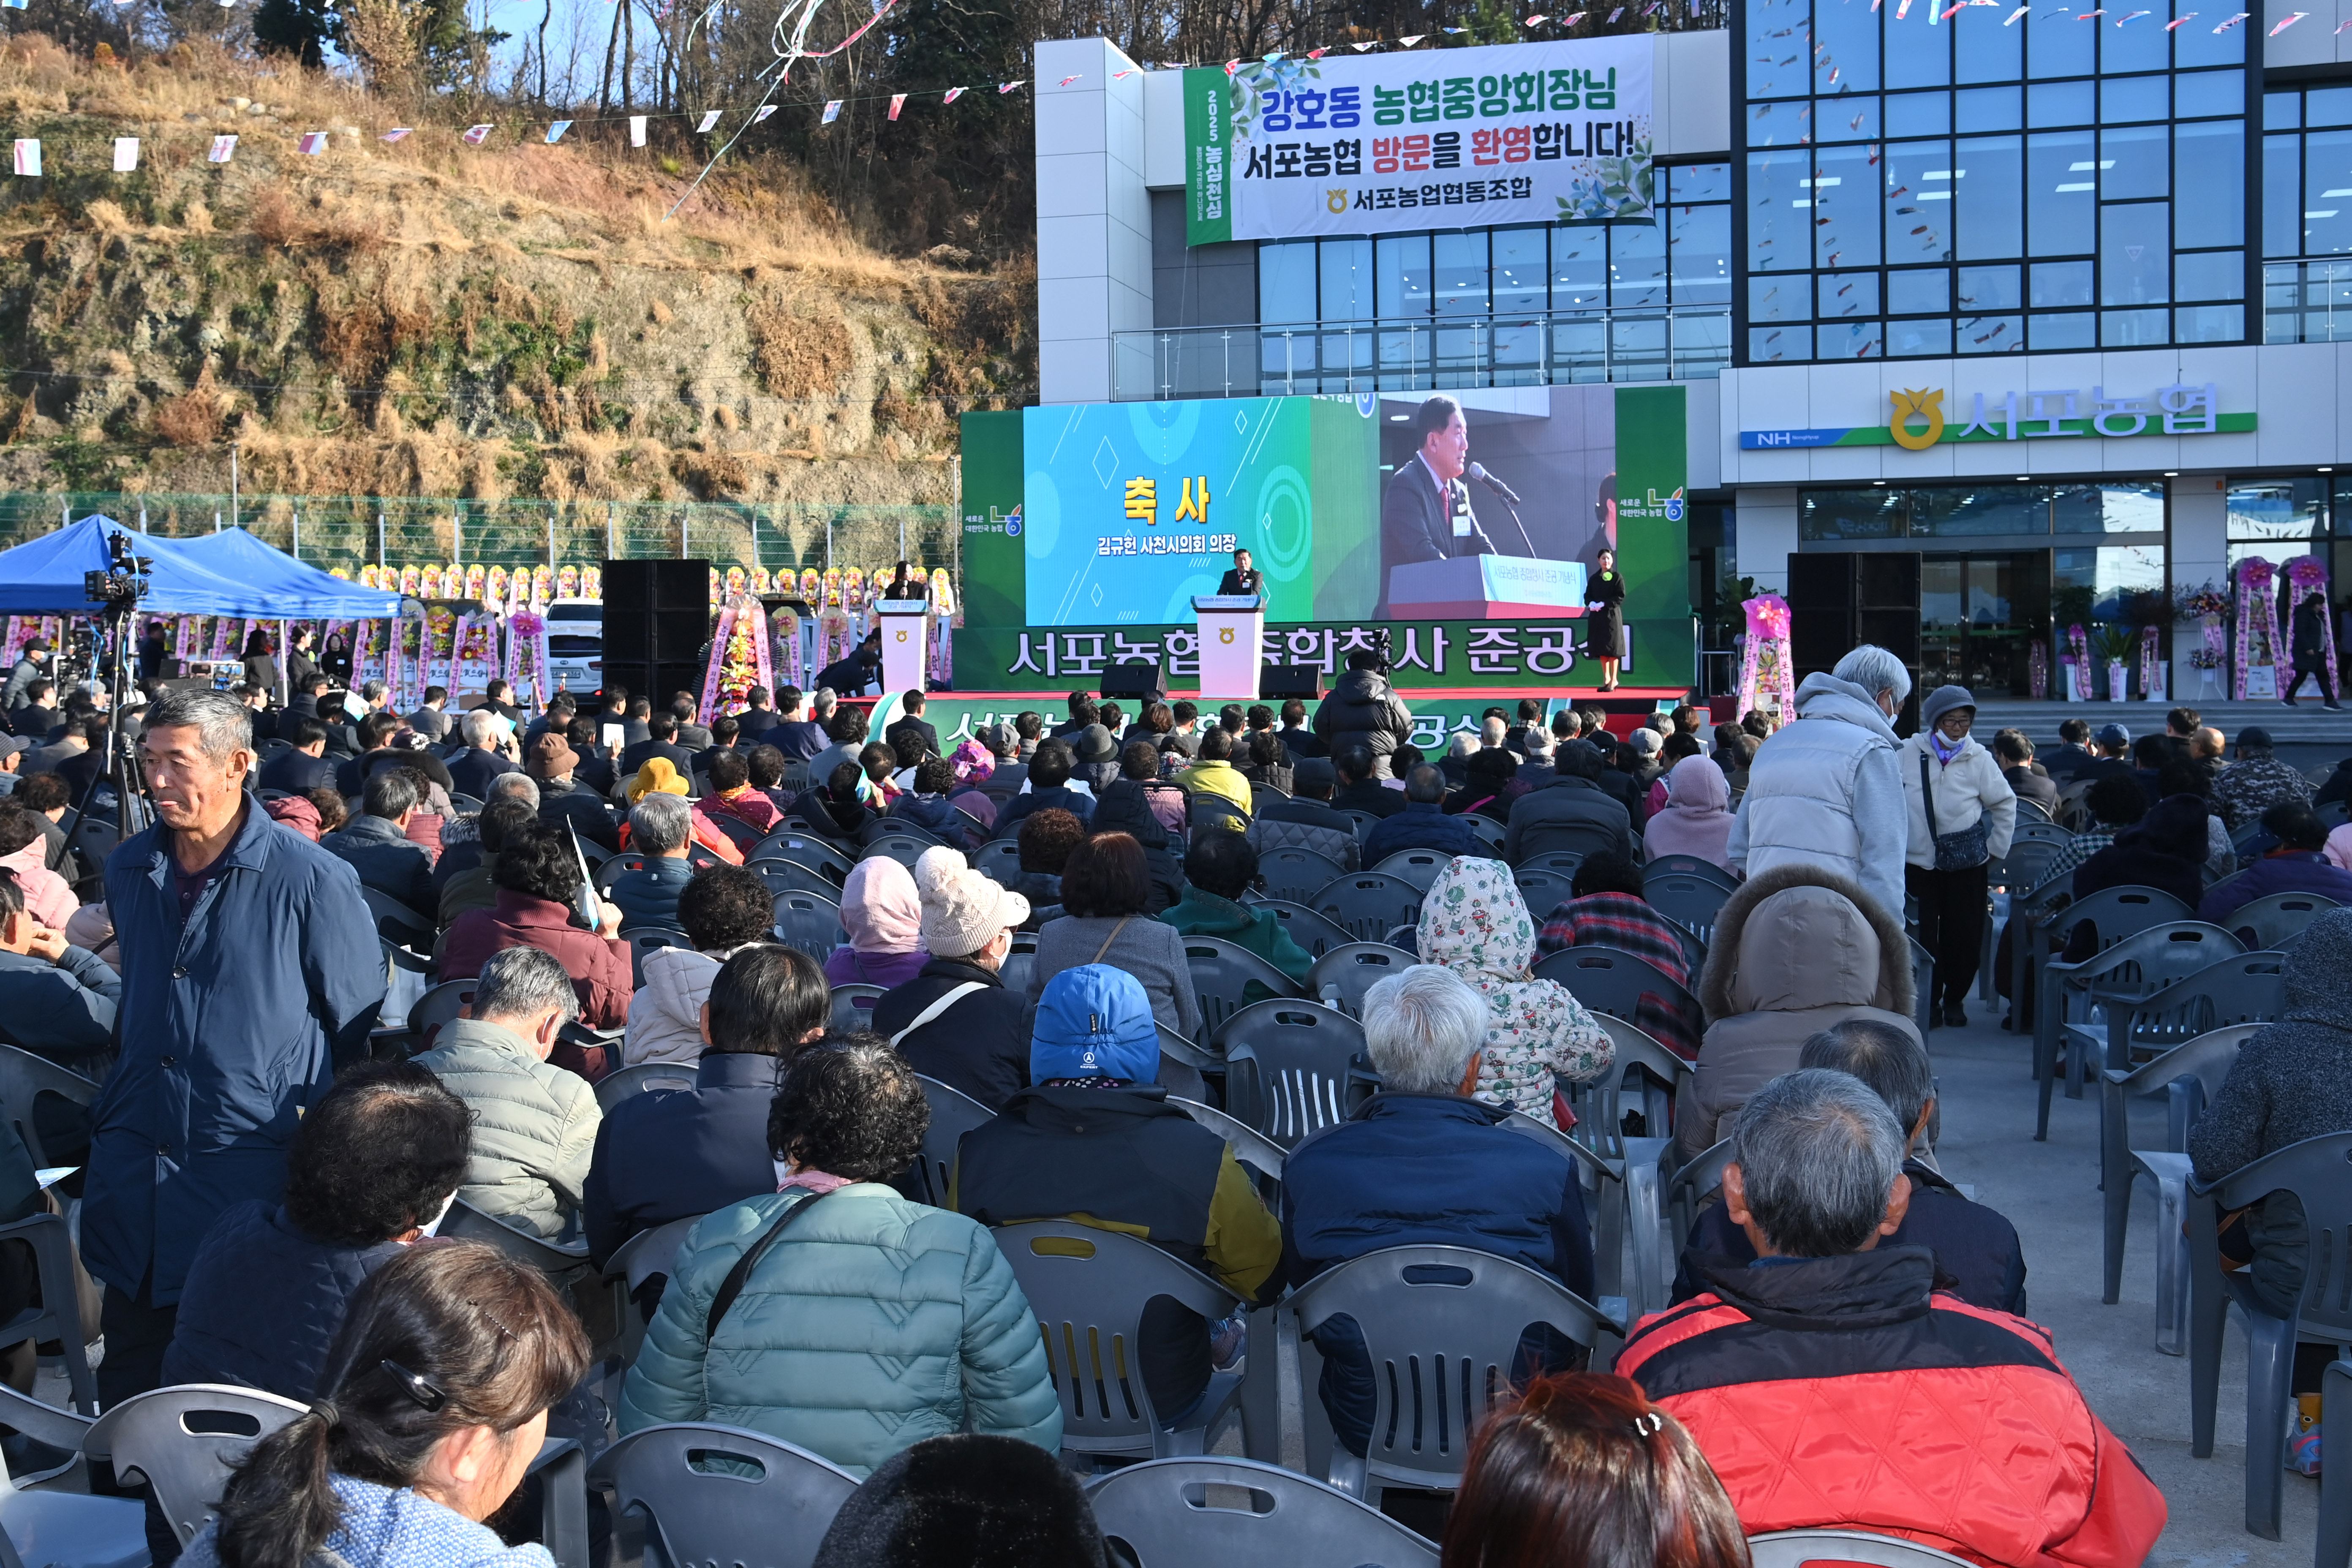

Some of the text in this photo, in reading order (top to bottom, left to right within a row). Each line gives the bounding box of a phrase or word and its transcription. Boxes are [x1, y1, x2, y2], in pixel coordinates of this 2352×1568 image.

[1208, 90, 1218, 142] 2025
[1261, 67, 1617, 132] 강호동 농협중앙회장님
[1244, 120, 1634, 180] 서포농협 방문을 환영합니다!
[1205, 145, 1223, 219] 농심천심
[1353, 177, 1533, 212] 서포농업협동조합
[1958, 383, 2216, 440] 서포농협
[1757, 432, 1790, 446] NH
[1124, 476, 1210, 525] 축 사
[1620, 498, 1641, 506] 새로운
[1620, 508, 1662, 517] 대한민국 농협
[991, 524, 1003, 532] 농협
[1097, 533, 1237, 556] 김규헌 사천시의회 의장
[1558, 570, 1577, 585] 기념식
[1007, 629, 1199, 676] 서포농협
[1466, 626, 1630, 674] 준공
[1779, 650, 1790, 692] 서포농협
